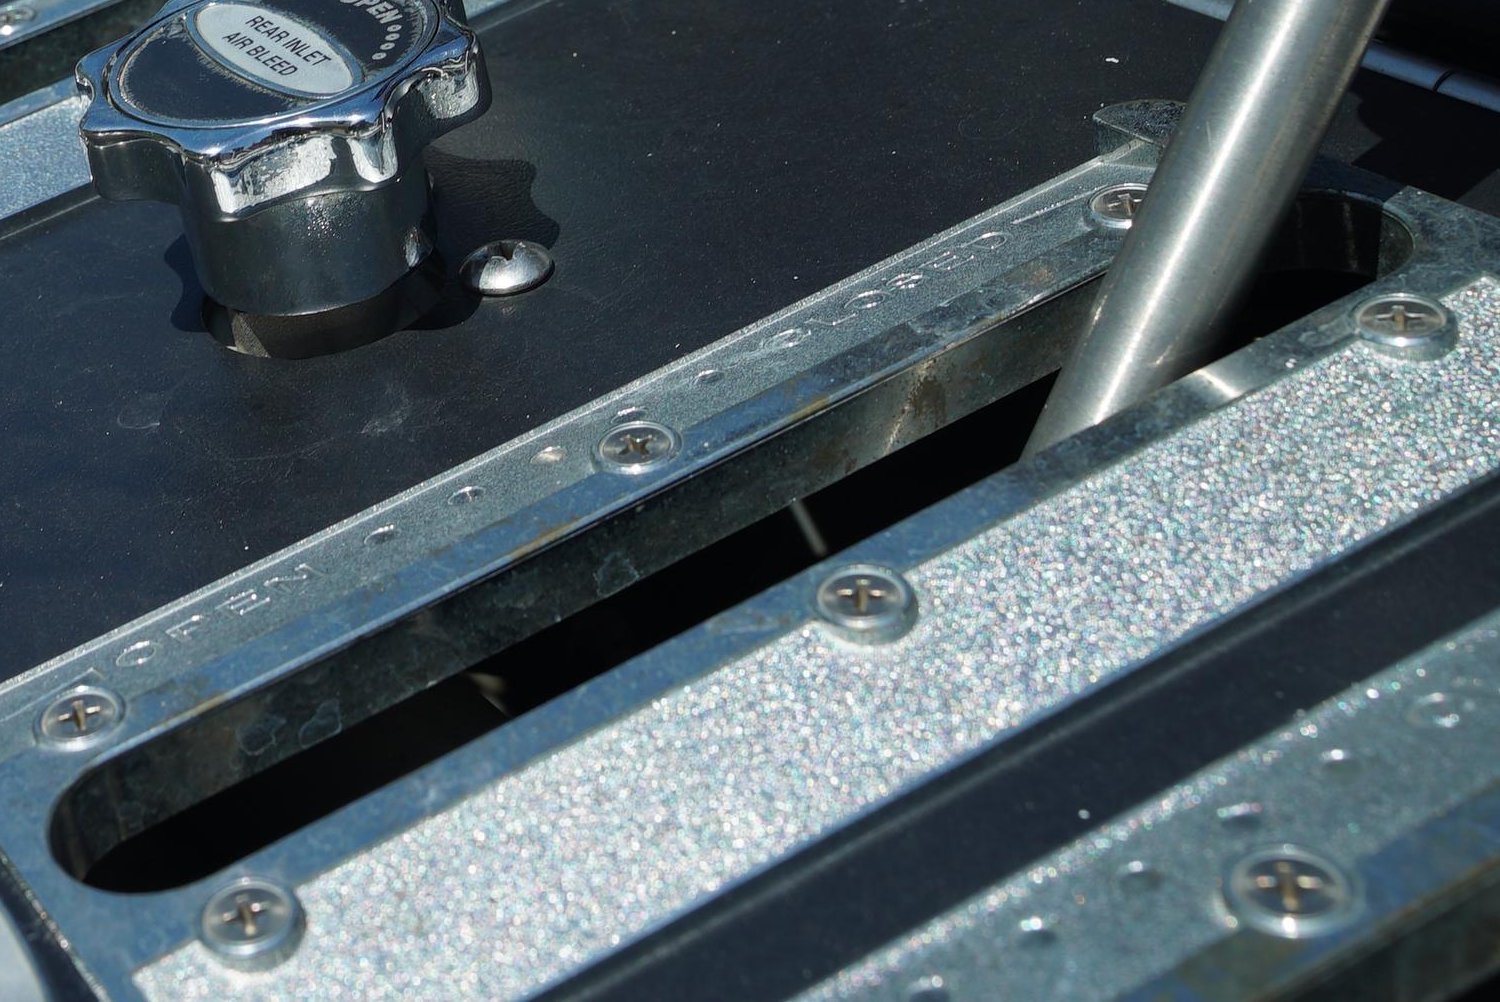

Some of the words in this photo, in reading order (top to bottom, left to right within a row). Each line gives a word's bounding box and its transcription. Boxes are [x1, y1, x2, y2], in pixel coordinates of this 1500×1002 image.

[222, 31, 253, 51] AIR
[246, 44, 298, 77] BLEED
[245, 15, 289, 43] REAR
[282, 36, 332, 67] INLET
